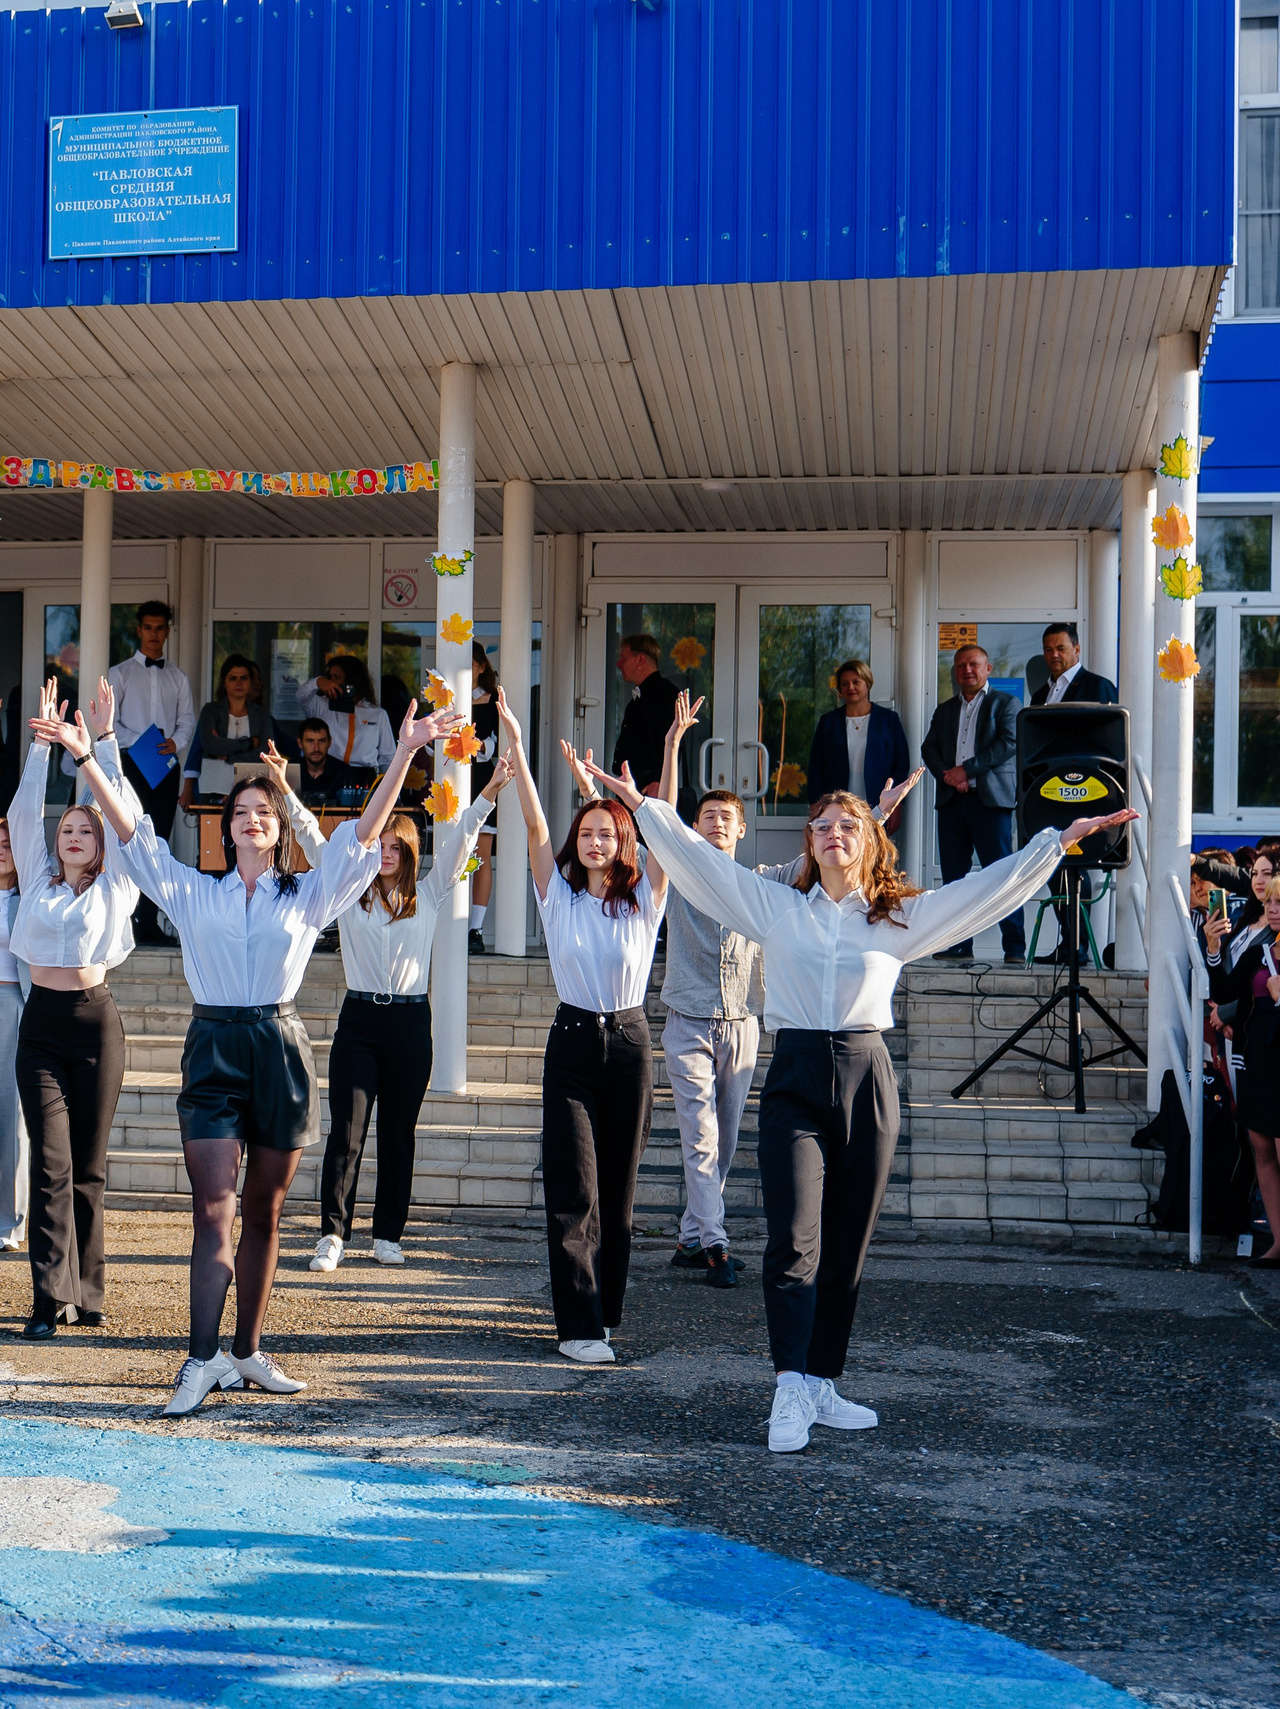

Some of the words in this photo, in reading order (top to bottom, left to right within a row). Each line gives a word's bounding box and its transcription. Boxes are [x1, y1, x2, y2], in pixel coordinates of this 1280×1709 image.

[69, 132, 133, 142] АДМИНИСТРАЦИИ
[134, 128, 186, 137] ПАВЛОВСКОГО
[187, 126, 217, 134] РАЙОНА
[91, 125, 125, 133] КОМИТЕТ
[140, 120, 195, 129] ОБРАЗОВАНИЮ
[65, 140, 155, 153] МУНИЦИПАЛЬНОЕ
[158, 136, 222, 147] БЮДЖЕТНОЕ
[57, 148, 166, 162] ОБЩЕОБРАЗОВАТЕЛЬНОЕ
[167, 144, 230, 155] УЧРЕЖДЕНИЕ
[110, 181, 175, 195] СРЕДНЯЯ
[55, 193, 232, 213] ОБЩЕОБРАЗОВАТЕЛЬНАЯ
[290, 455, 439, 497] ШКОЛА!
[1058, 787, 1087, 796] 1500
